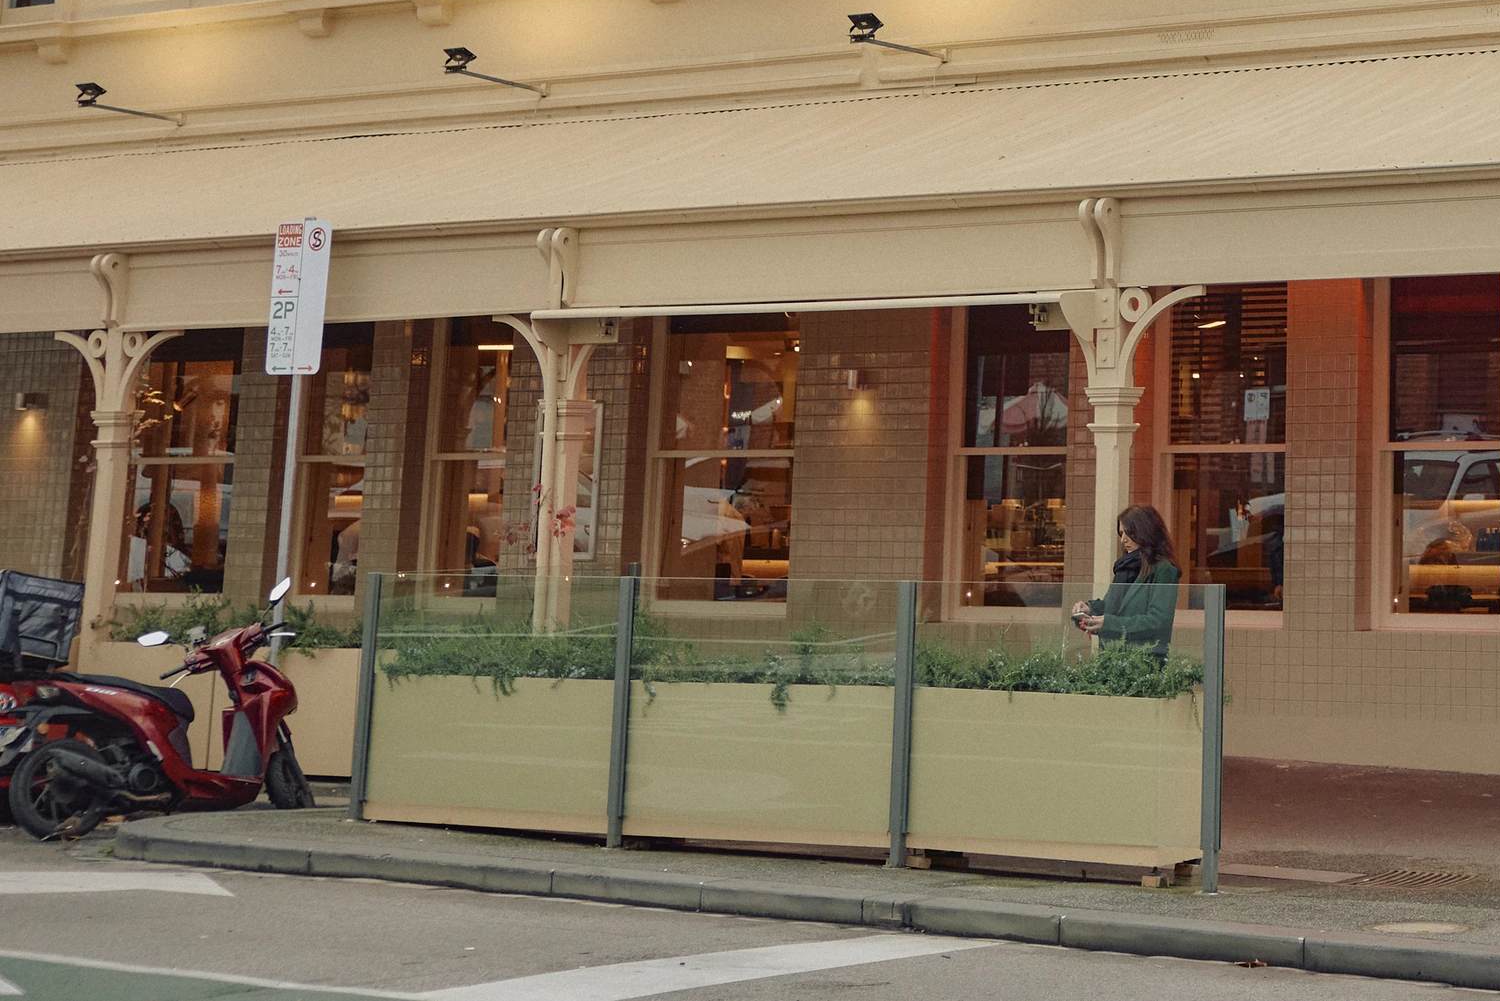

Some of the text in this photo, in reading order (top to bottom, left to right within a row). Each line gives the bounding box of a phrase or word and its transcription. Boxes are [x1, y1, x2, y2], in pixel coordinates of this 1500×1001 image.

[279, 224, 303, 236] LOADING
[278, 236, 303, 247] ZONE
[272, 301, 295, 320] 2P
